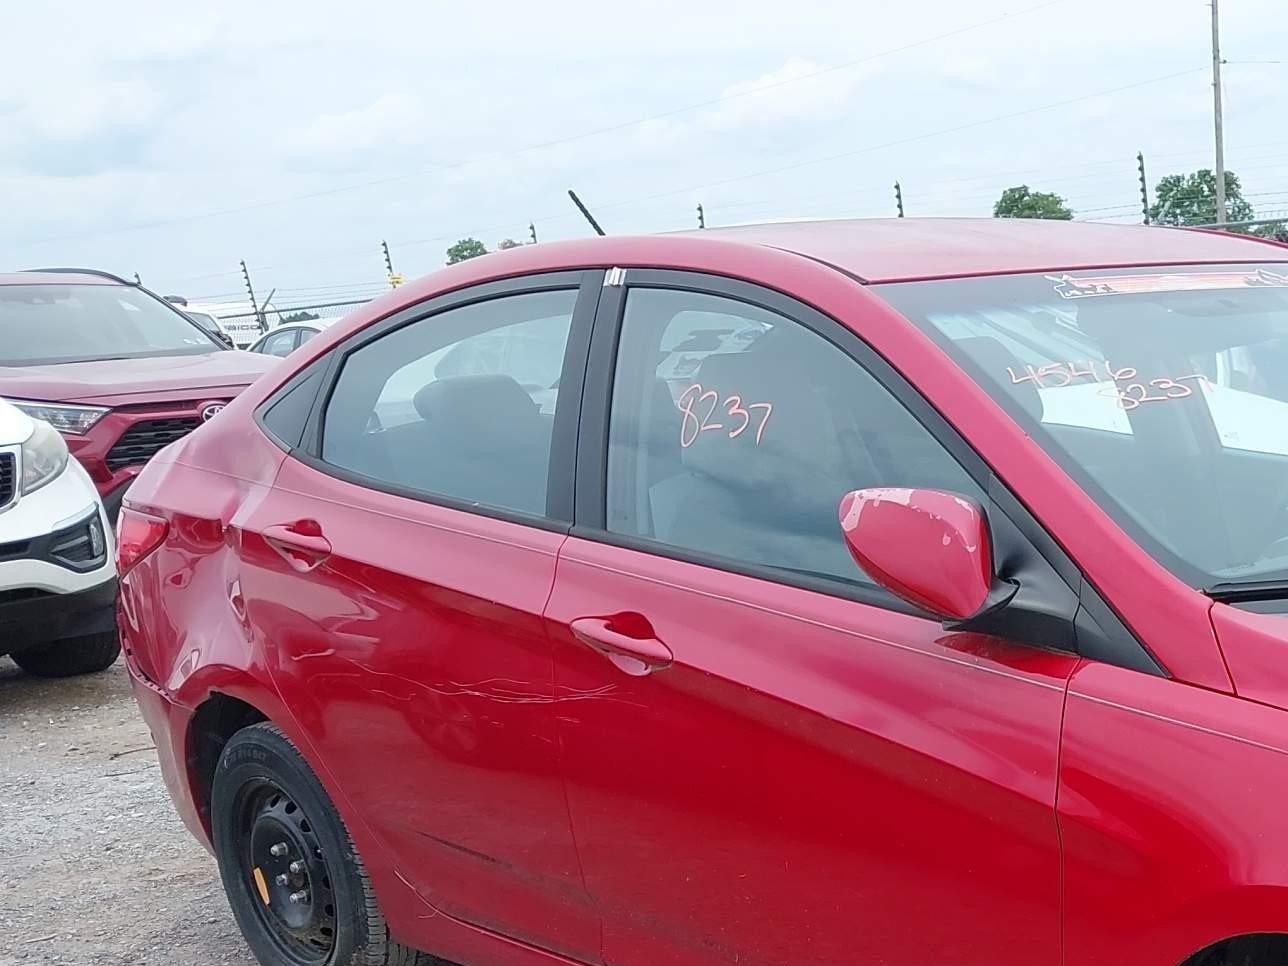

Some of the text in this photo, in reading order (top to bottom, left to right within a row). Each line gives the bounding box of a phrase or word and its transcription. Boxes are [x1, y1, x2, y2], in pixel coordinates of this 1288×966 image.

[1006, 360, 1138, 388] 4546
[1096, 374, 1214, 410] 8237
[677, 383, 773, 448] 8237
